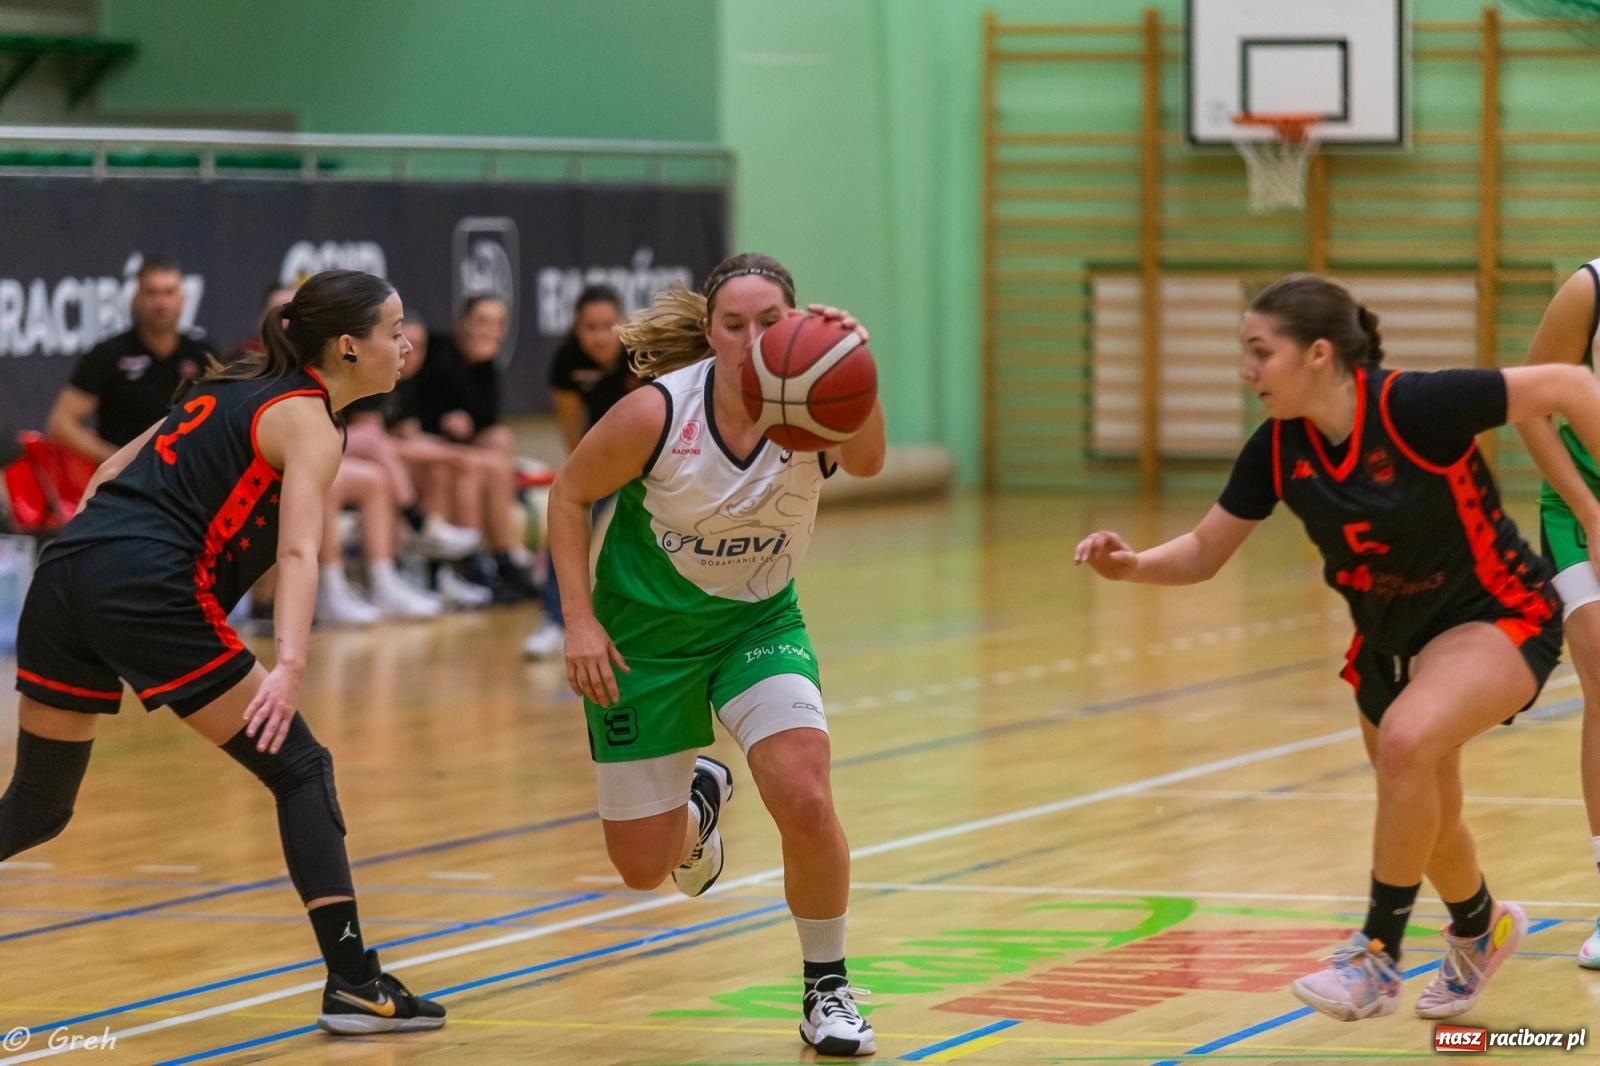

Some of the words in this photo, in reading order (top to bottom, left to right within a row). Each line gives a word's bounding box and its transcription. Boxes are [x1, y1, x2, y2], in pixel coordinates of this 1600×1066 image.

[154, 394, 217, 466] 2
[1342, 521, 1391, 555] 5
[603, 705, 639, 747] 3
